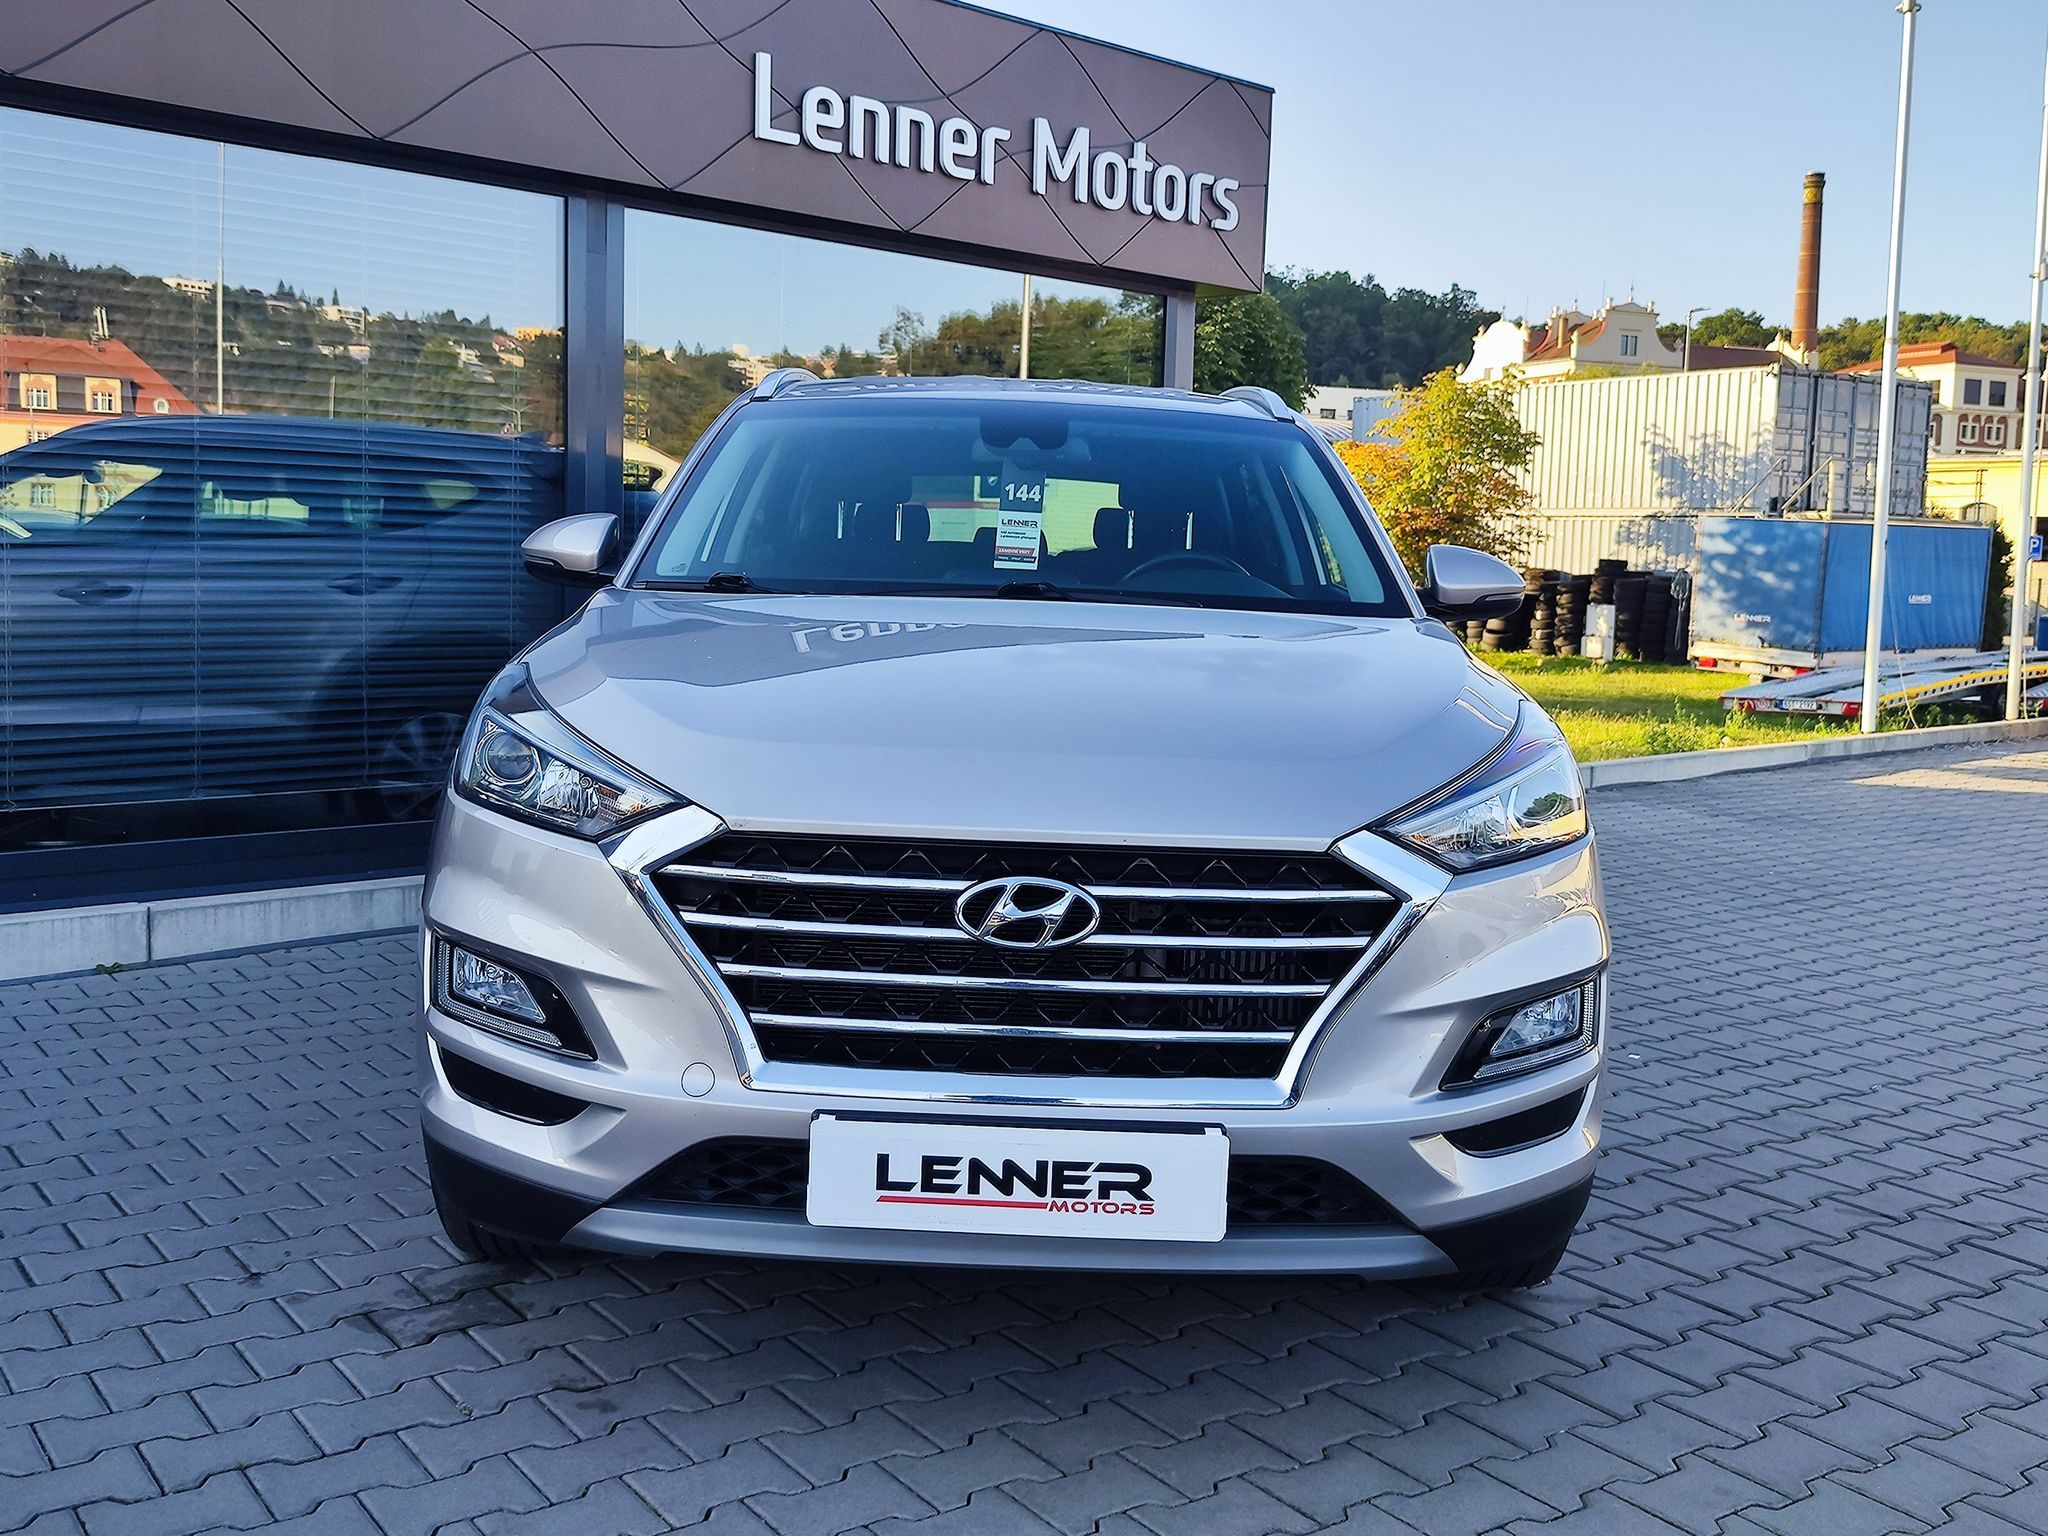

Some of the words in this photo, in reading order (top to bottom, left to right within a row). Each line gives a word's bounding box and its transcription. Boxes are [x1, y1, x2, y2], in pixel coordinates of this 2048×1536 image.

[754, 51, 1011, 185] Lenner
[1032, 116, 1239, 231] Motors
[1005, 483, 1041, 502] 144
[1001, 518, 1038, 528] LENNER
[2030, 538, 2039, 553] P
[876, 1153, 1155, 1201] LENNER
[1048, 1200, 1155, 1215] MOTORS
